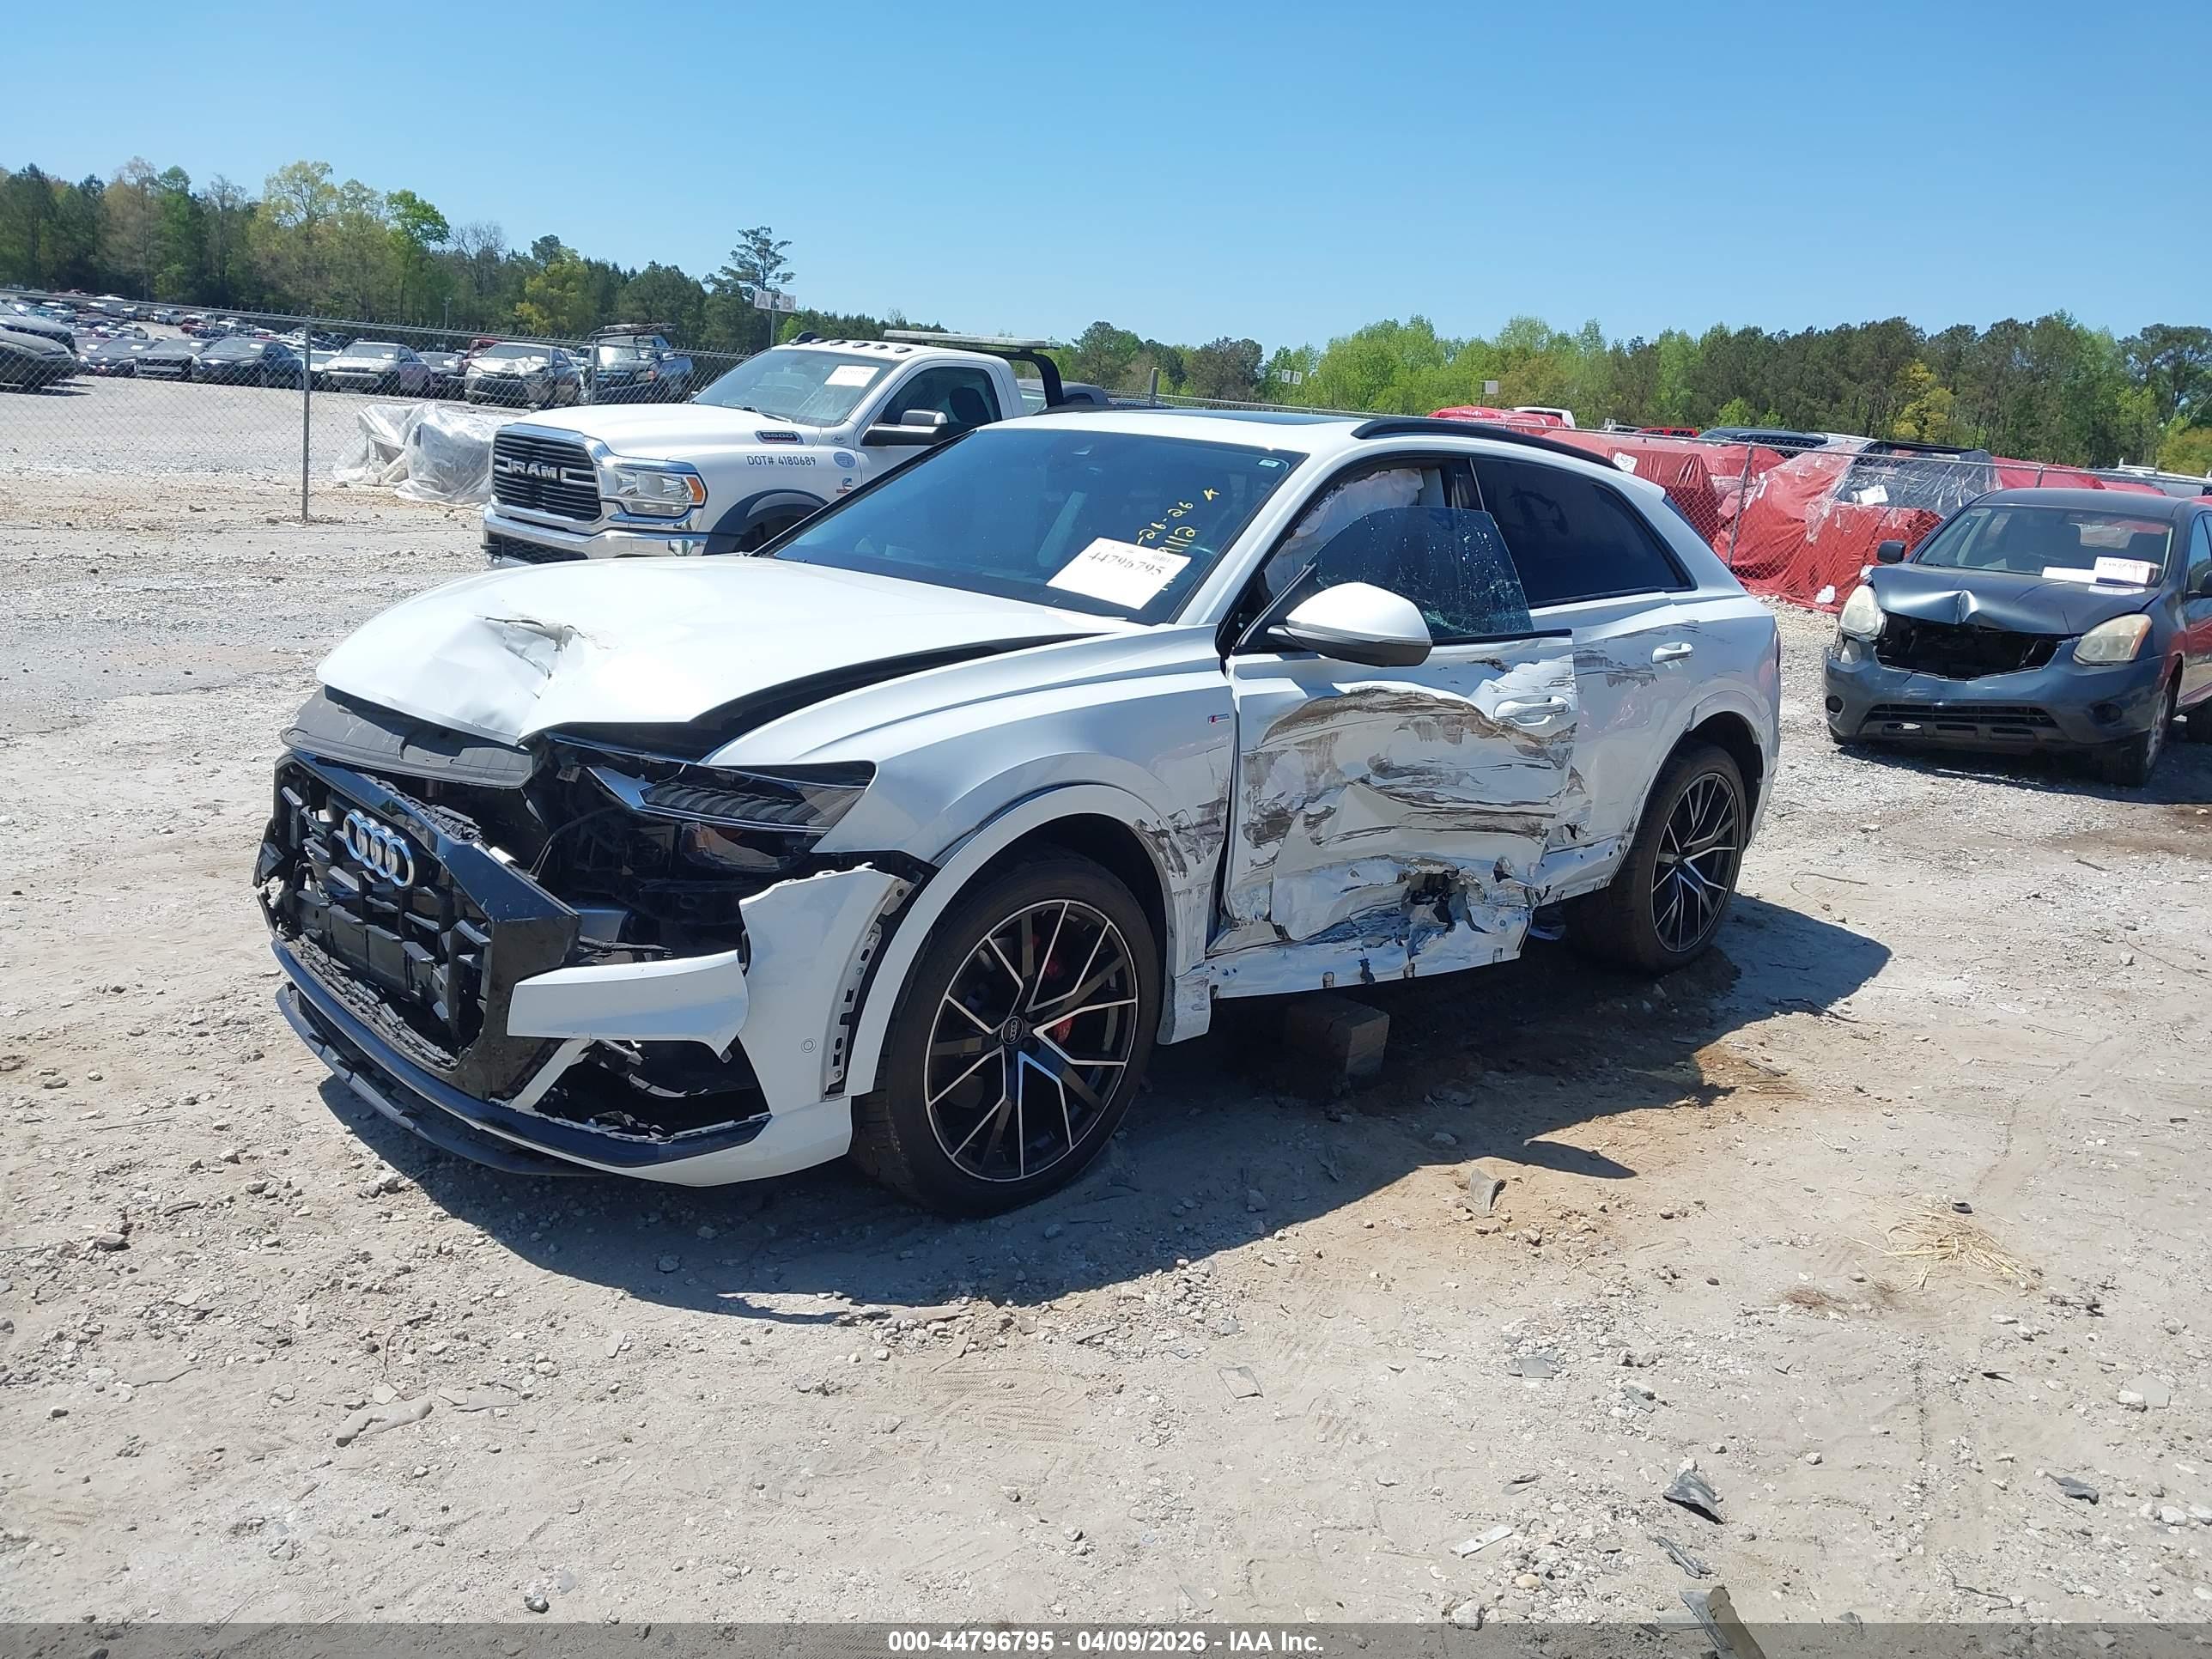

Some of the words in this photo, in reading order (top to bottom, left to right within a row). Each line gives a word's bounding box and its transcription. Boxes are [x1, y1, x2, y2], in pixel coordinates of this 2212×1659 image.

[756, 292, 769, 307] A
[782, 295, 793, 310] B
[1294, 373, 1300, 383] D
[746, 455, 775, 465] DOT#
[778, 456, 816, 466] 4180689
[512, 459, 558, 480] RAM
[1088, 551, 1168, 576] 44796795
